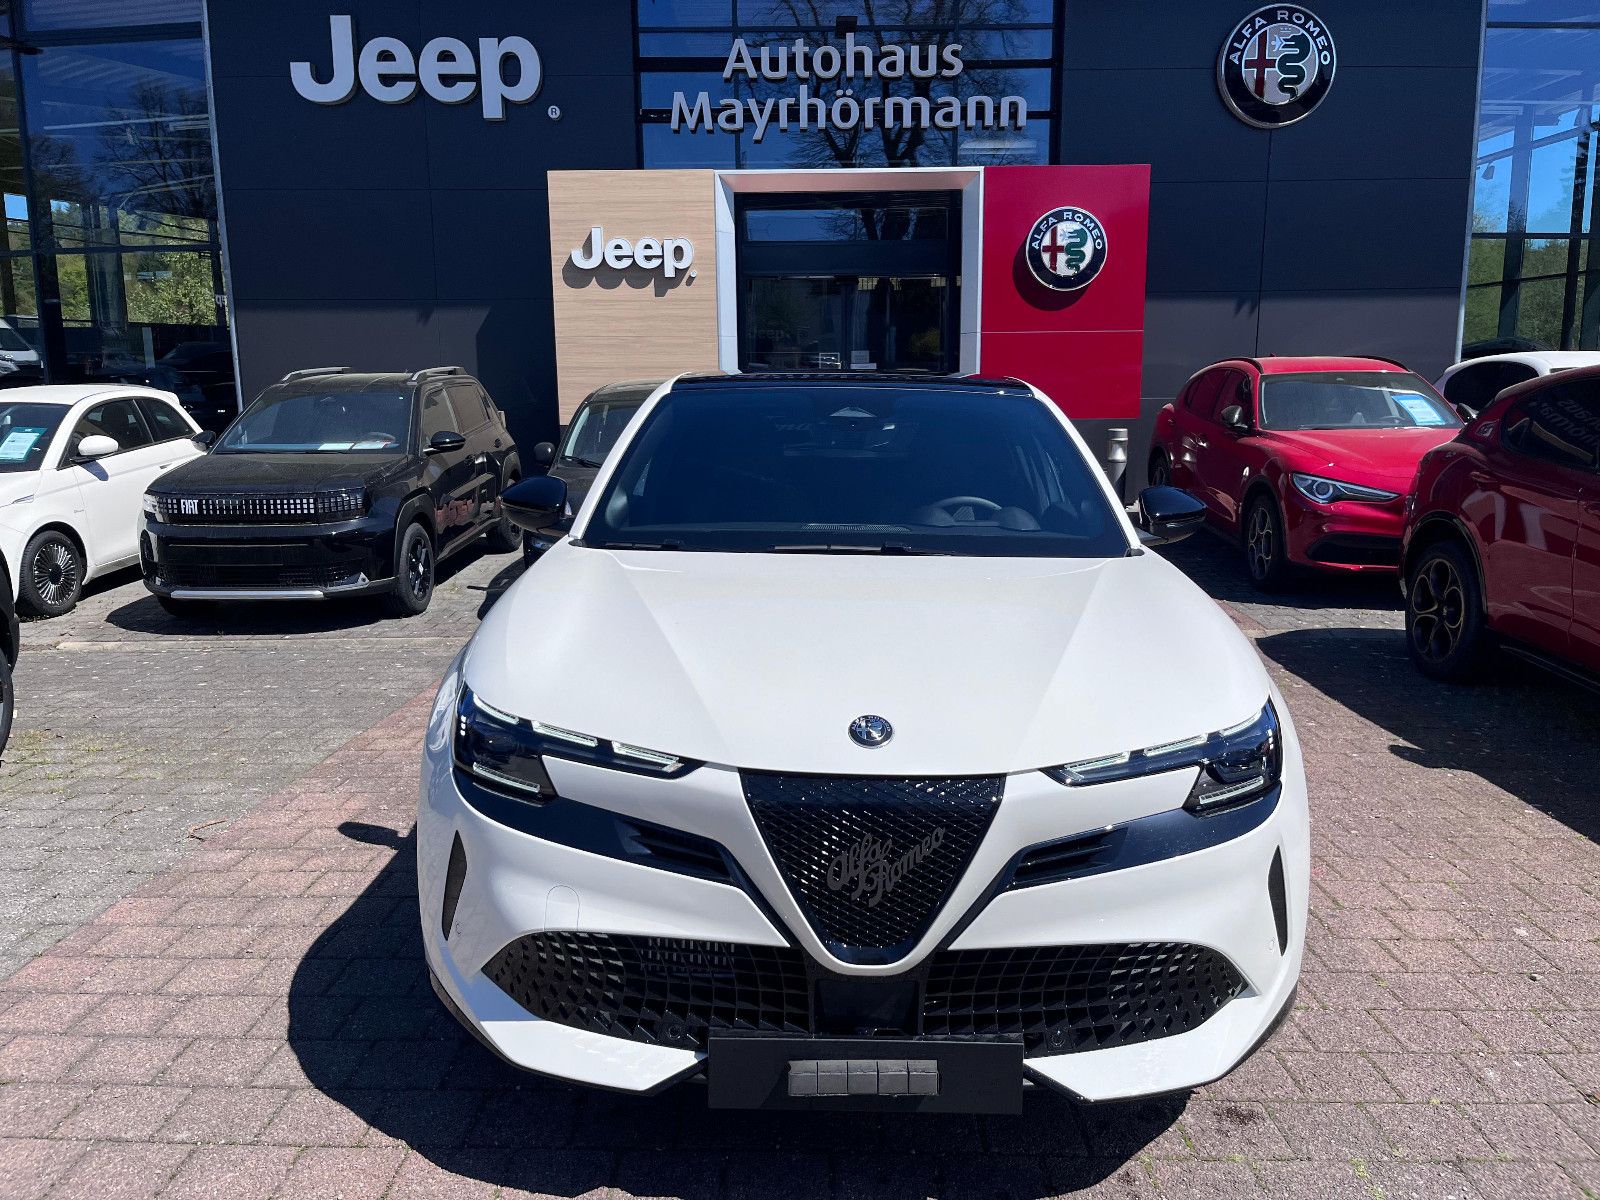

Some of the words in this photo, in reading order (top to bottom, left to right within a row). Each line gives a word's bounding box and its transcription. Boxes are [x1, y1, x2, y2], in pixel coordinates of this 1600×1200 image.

[722, 32, 964, 80] Autohaus
[1229, 16, 1268, 65] ALFA
[1276, 10, 1331, 65] ROMEO
[290, 15, 542, 120] Jeep
[670, 84, 1028, 142] Mayrhörmann
[571, 226, 695, 278] Jeep
[1031, 216, 1058, 250] ALFA
[1063, 211, 1103, 250] ROMEO
[180, 499, 199, 515] FIAT
